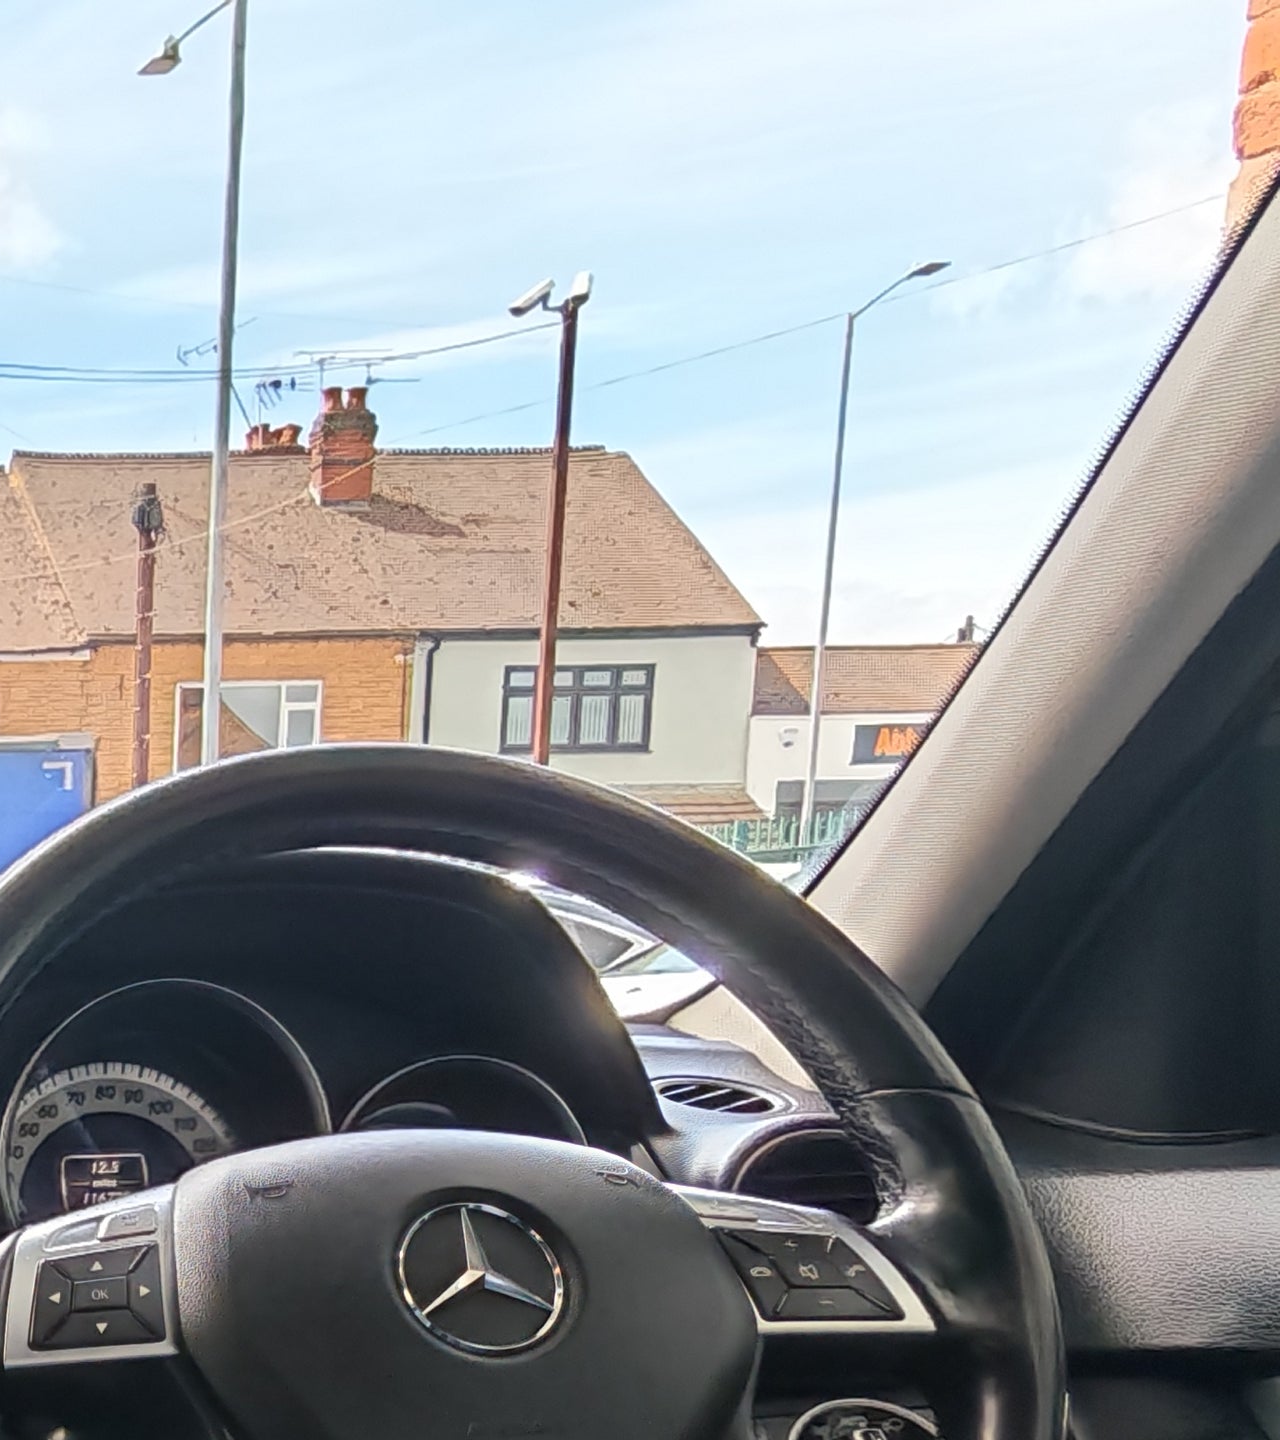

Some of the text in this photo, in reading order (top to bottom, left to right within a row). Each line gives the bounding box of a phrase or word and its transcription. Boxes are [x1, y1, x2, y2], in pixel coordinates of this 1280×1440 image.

[66, 1091, 86, 1106] 70
[95, 1085, 116, 1100] 80
[123, 1088, 143, 1104] 90
[91, 1288, 110, 1300] OK
